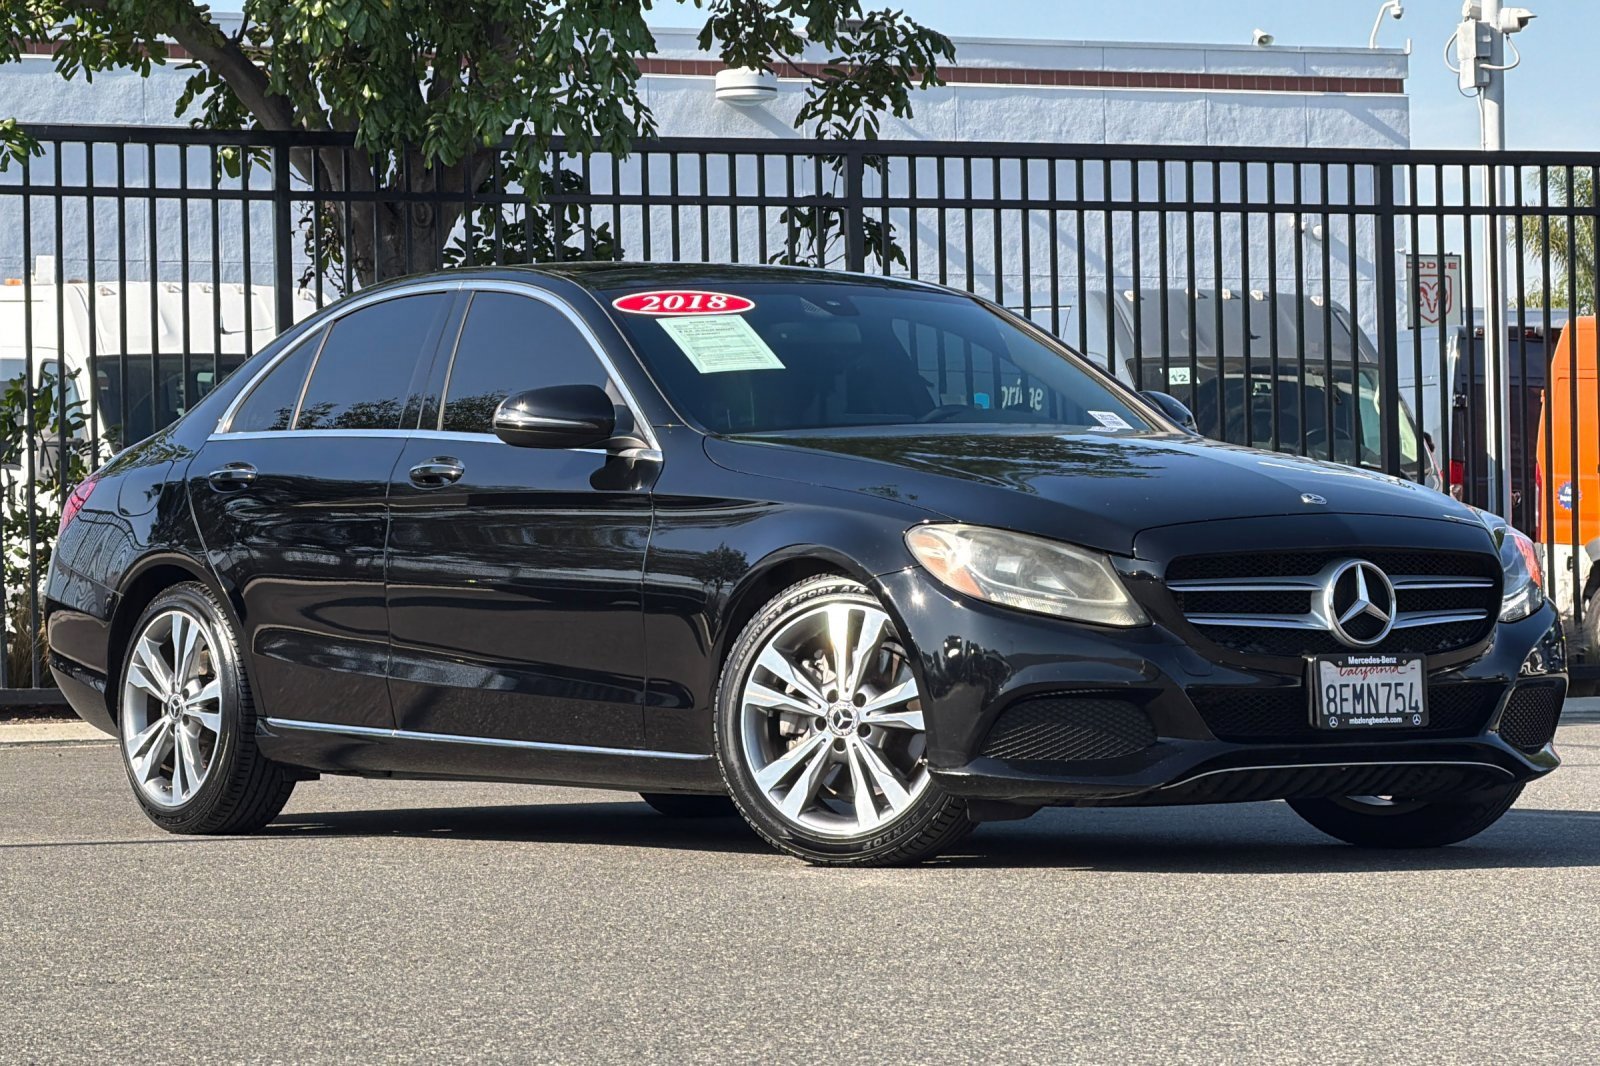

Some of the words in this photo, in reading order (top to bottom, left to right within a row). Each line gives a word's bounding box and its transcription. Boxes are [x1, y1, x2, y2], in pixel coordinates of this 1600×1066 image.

[639, 295, 728, 311] 2018
[1171, 374, 1189, 382] 12
[790, 586, 836, 606] SPORT
[1348, 656, 1397, 665] Mercedes-Benz
[1339, 666, 1406, 680] California
[1326, 682, 1420, 715] 8EMN754
[1349, 716, 1402, 726] mbzlongbeach.com
[862, 811, 920, 850] DUNLOP
